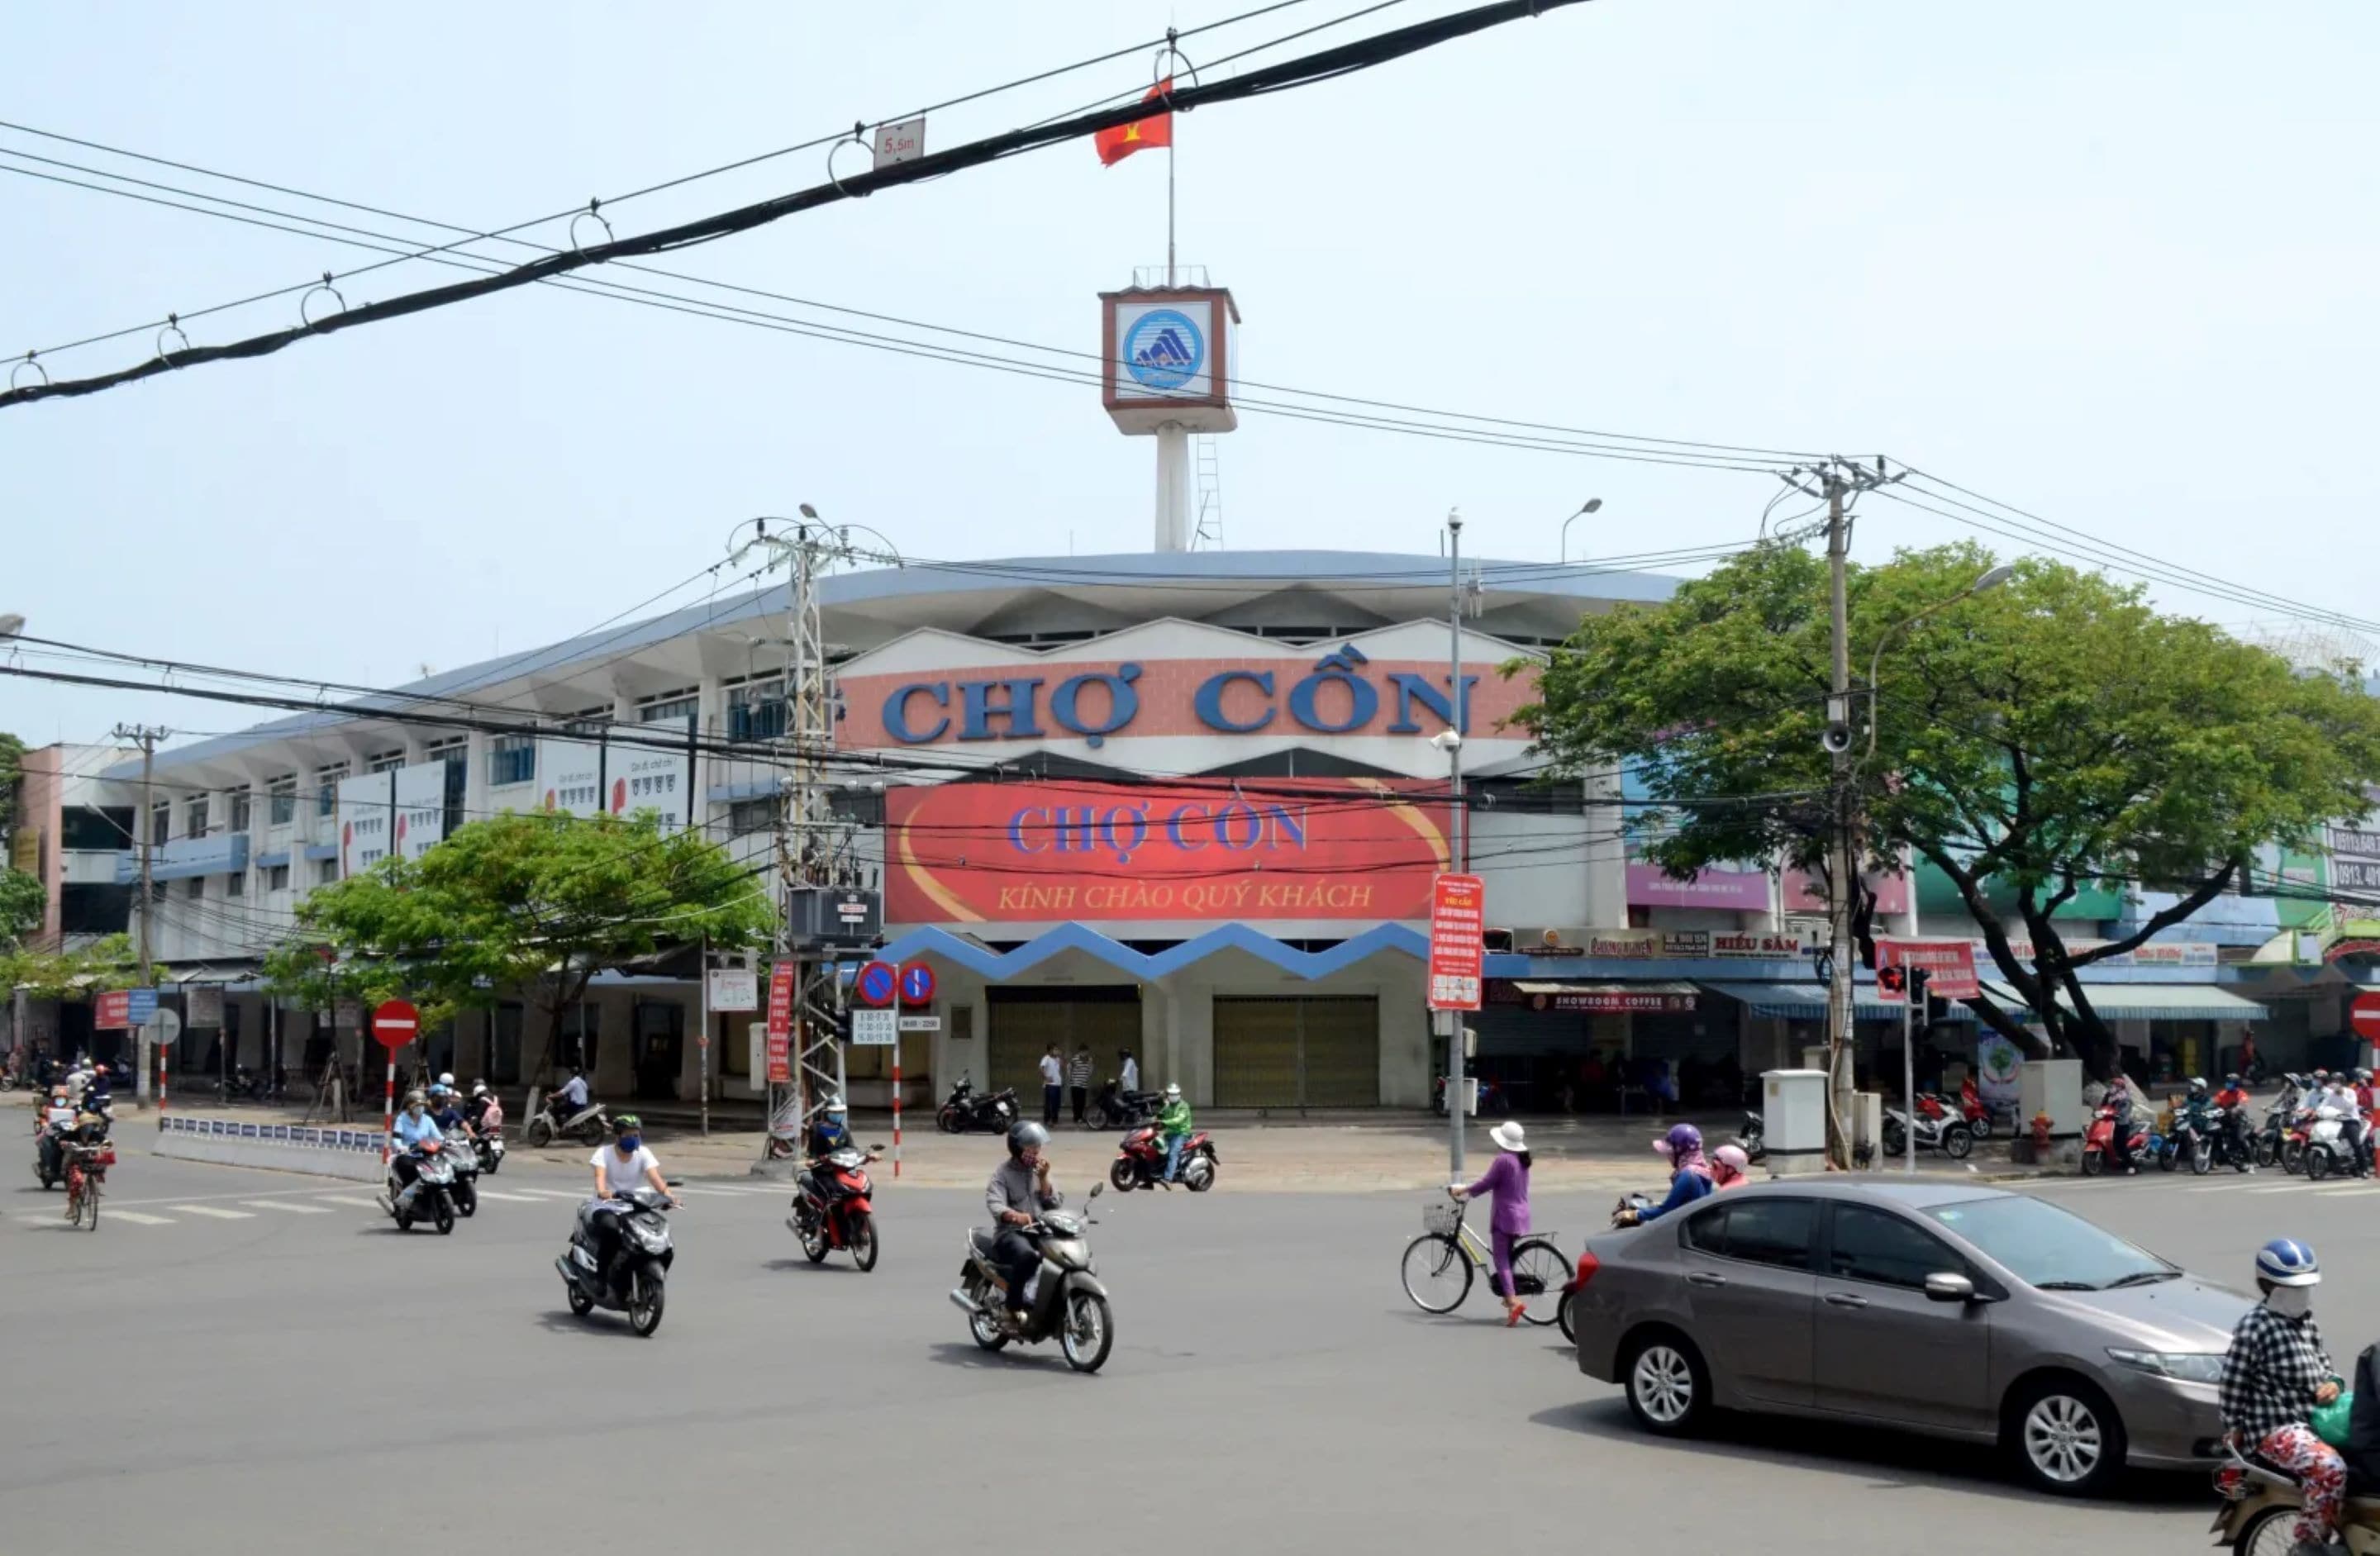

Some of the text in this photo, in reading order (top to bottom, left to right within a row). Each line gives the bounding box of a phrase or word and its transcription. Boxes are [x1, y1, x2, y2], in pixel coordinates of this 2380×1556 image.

[882, 642, 1479, 749] CHỢ CỒN
[1007, 799, 1152, 864] CHỢ
[998, 878, 1374, 912] KÍNH CHÀO QUÝ KHÁCH
[1556, 997, 1619, 1006] SHOWROOM
